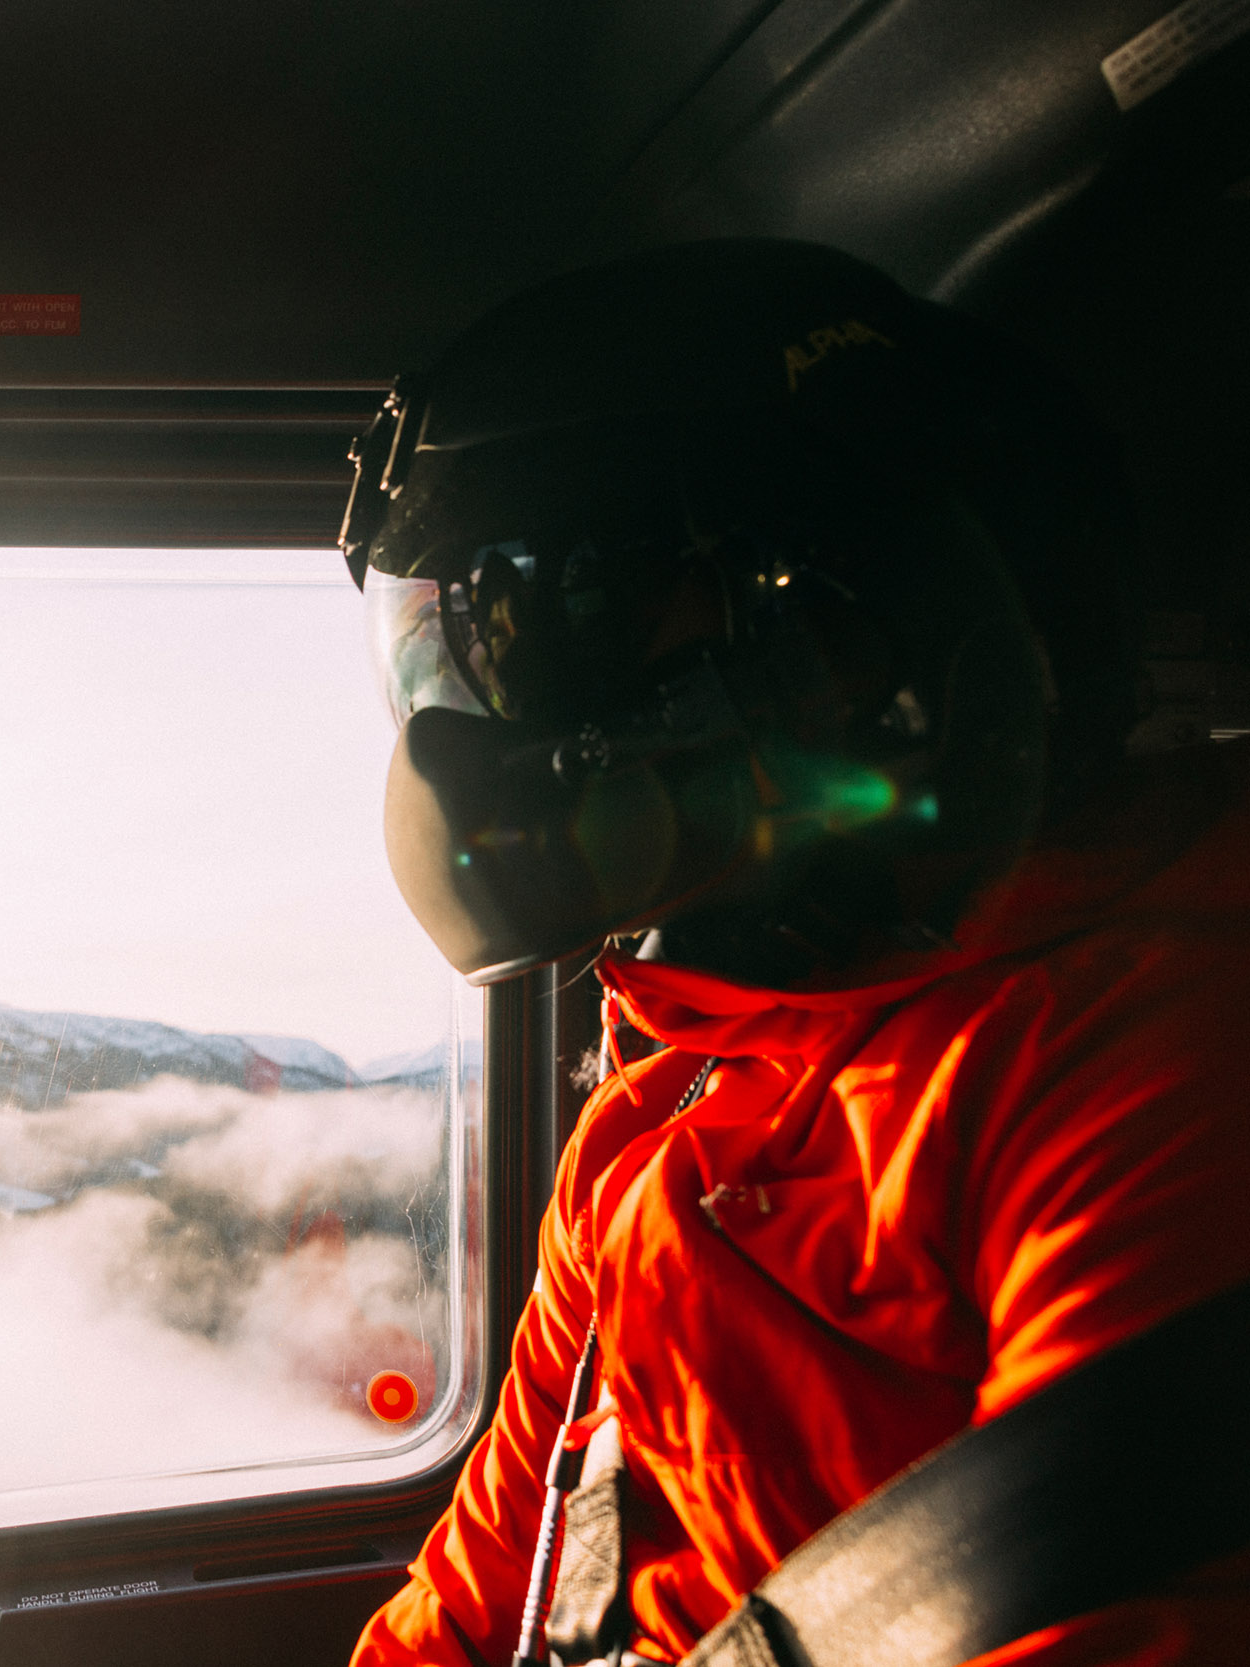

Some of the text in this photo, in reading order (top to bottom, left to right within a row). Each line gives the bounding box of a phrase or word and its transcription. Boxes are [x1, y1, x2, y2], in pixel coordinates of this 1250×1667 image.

[13, 302, 40, 311] WITH
[45, 302, 76, 311] OPEN
[25, 319, 39, 329] TO
[44, 319, 66, 329] FLM
[785, 320, 895, 392] ALPHA
[17, 1586, 159, 1609] HANDLE DURING FLIGHT
[41, 1592, 65, 1600] NOT
[68, 1585, 120, 1597] OPERATE
[123, 1580, 157, 1590] DOOR
